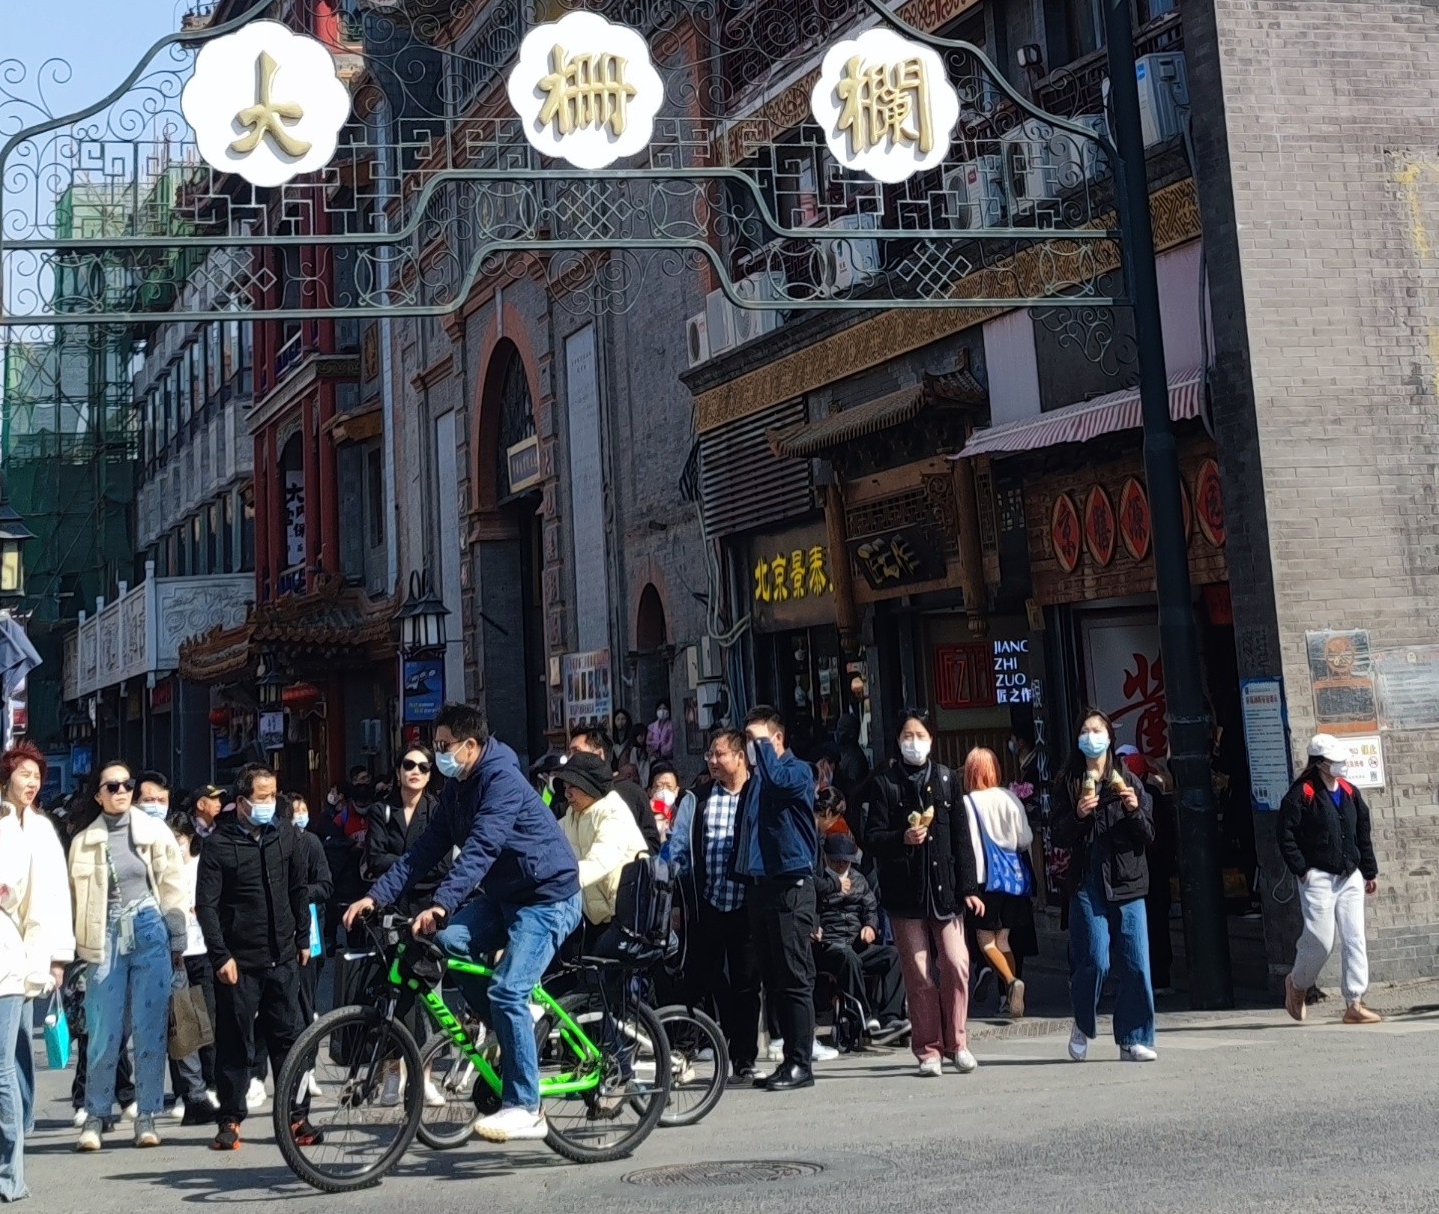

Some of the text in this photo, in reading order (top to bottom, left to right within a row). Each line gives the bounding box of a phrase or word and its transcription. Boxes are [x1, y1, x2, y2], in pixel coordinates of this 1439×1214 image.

[754, 545, 835, 603] 北京景泰
[993, 656, 1018, 671] ZHI
[995, 672, 1027, 687] ZUO
[996, 687, 1033, 704] 匠之作
